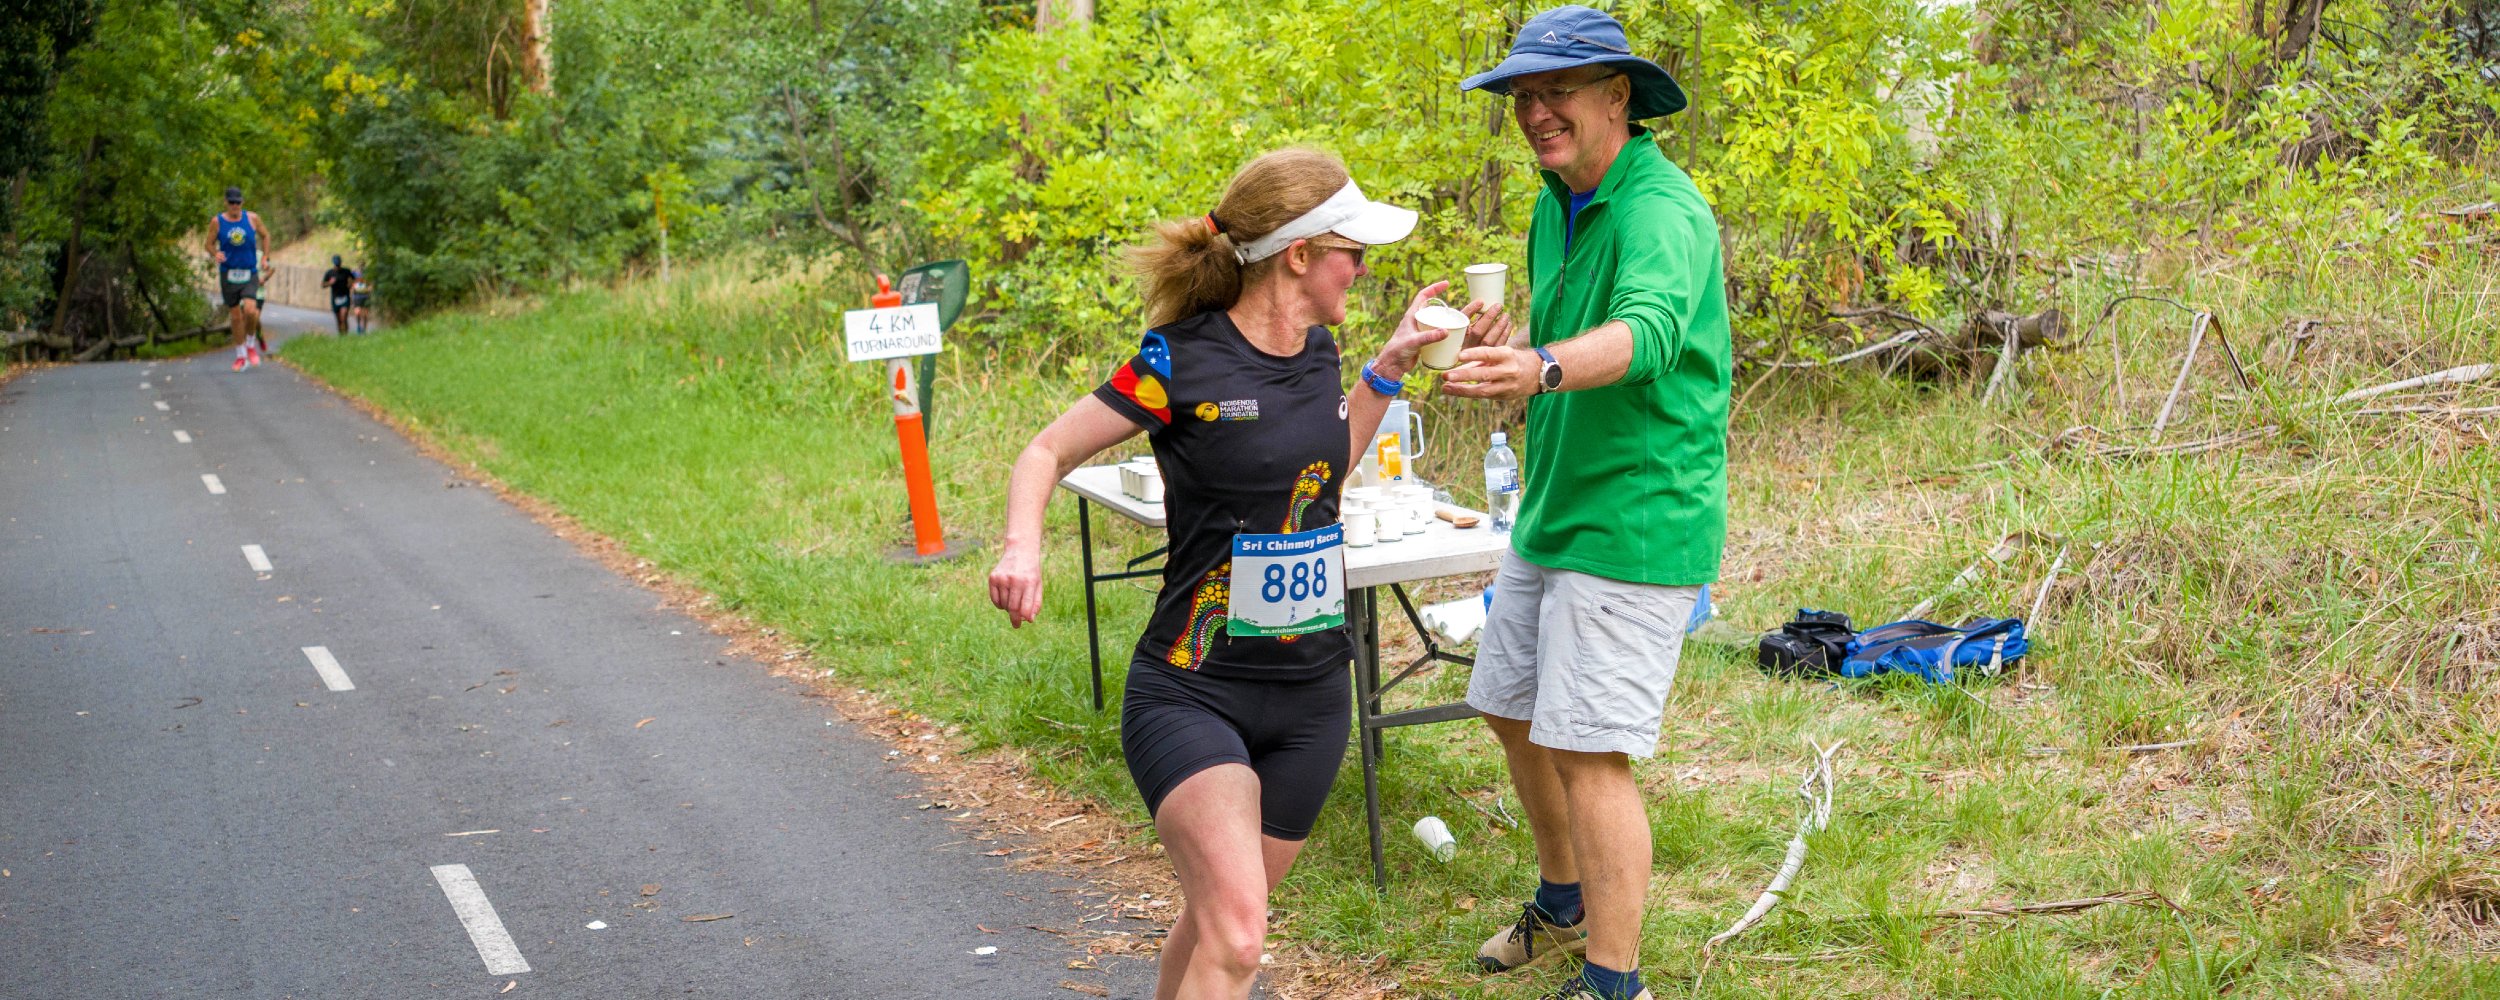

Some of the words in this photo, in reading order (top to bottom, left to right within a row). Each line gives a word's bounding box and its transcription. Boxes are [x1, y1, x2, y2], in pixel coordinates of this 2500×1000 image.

[869, 313, 883, 334] 4
[890, 314, 916, 332] KM
[851, 334, 937, 354] TURNAROUND
[1219, 399, 1257, 408] INDIGENOUS
[1220, 405, 1259, 413] MARATHON
[1242, 541, 1262, 551] Sri
[1267, 538, 1315, 550] Chinmoy
[1316, 532, 1339, 545] Races
[1261, 557, 1327, 603] 888
